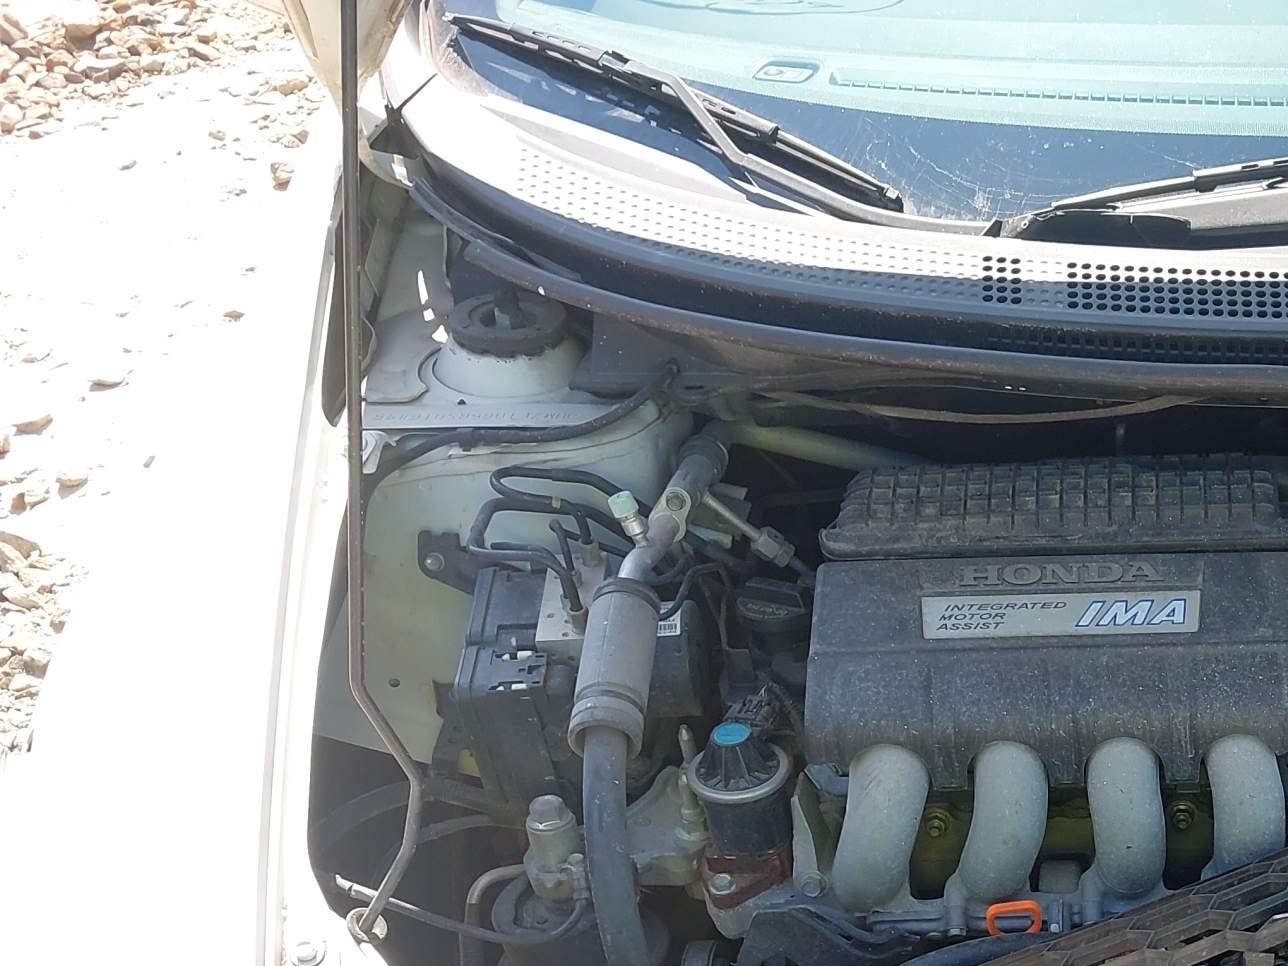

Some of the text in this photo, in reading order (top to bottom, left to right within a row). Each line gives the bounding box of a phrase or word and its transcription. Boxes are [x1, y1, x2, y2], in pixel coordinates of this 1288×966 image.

[959, 562, 1165, 586] HONDA
[944, 601, 1067, 612] INTEGRATED
[939, 612, 1007, 622] MOTOR
[1075, 599, 1187, 627] IMA
[936, 622, 1005, 631] ASSIST
